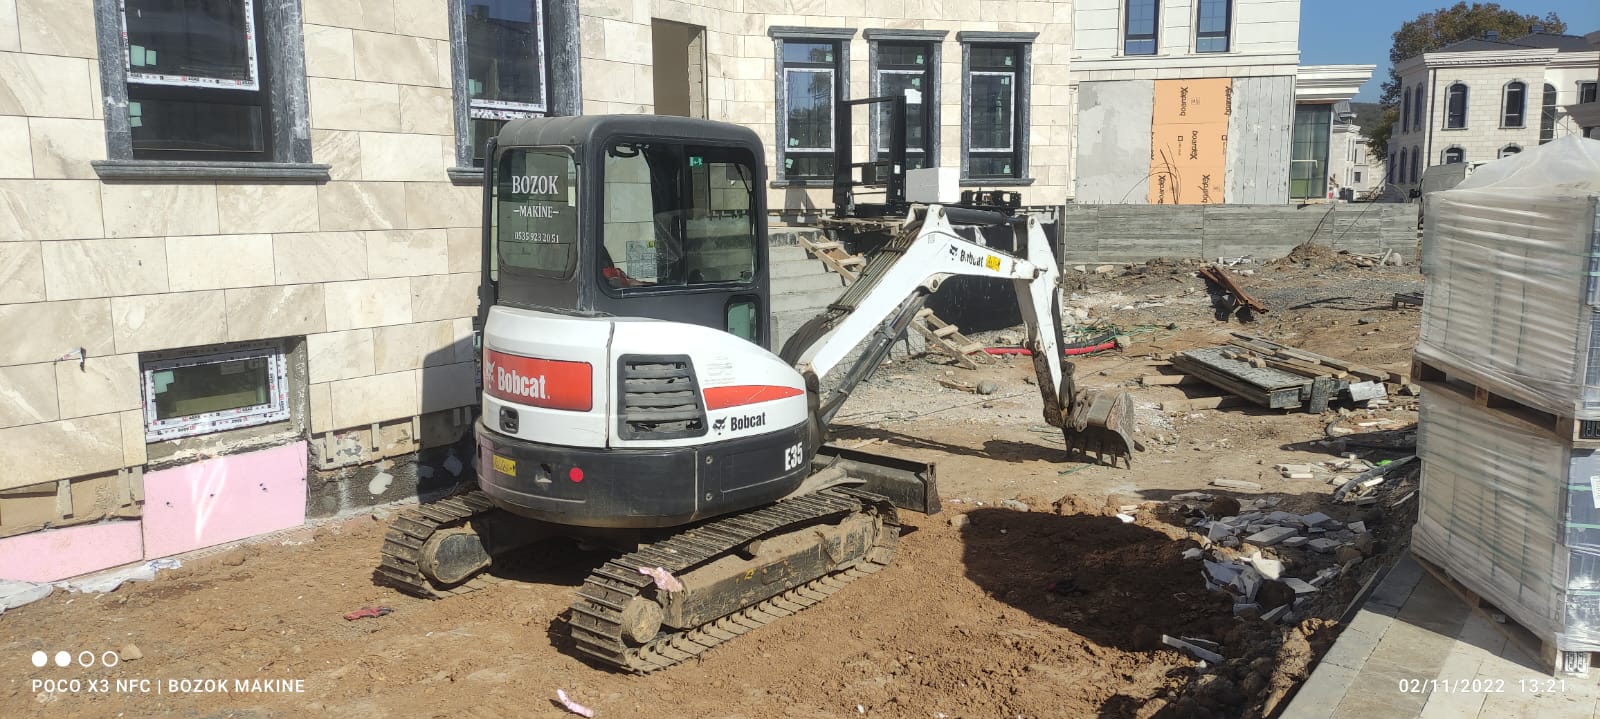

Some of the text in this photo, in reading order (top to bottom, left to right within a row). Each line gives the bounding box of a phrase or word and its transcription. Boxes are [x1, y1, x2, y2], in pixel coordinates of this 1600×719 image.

[511, 175, 559, 194] BOZOK
[514, 231, 560, 243] 0535 923 20 51
[497, 366, 546, 400] Bobcat
[730, 411, 766, 431] Bobcat
[785, 441, 803, 471] E35
